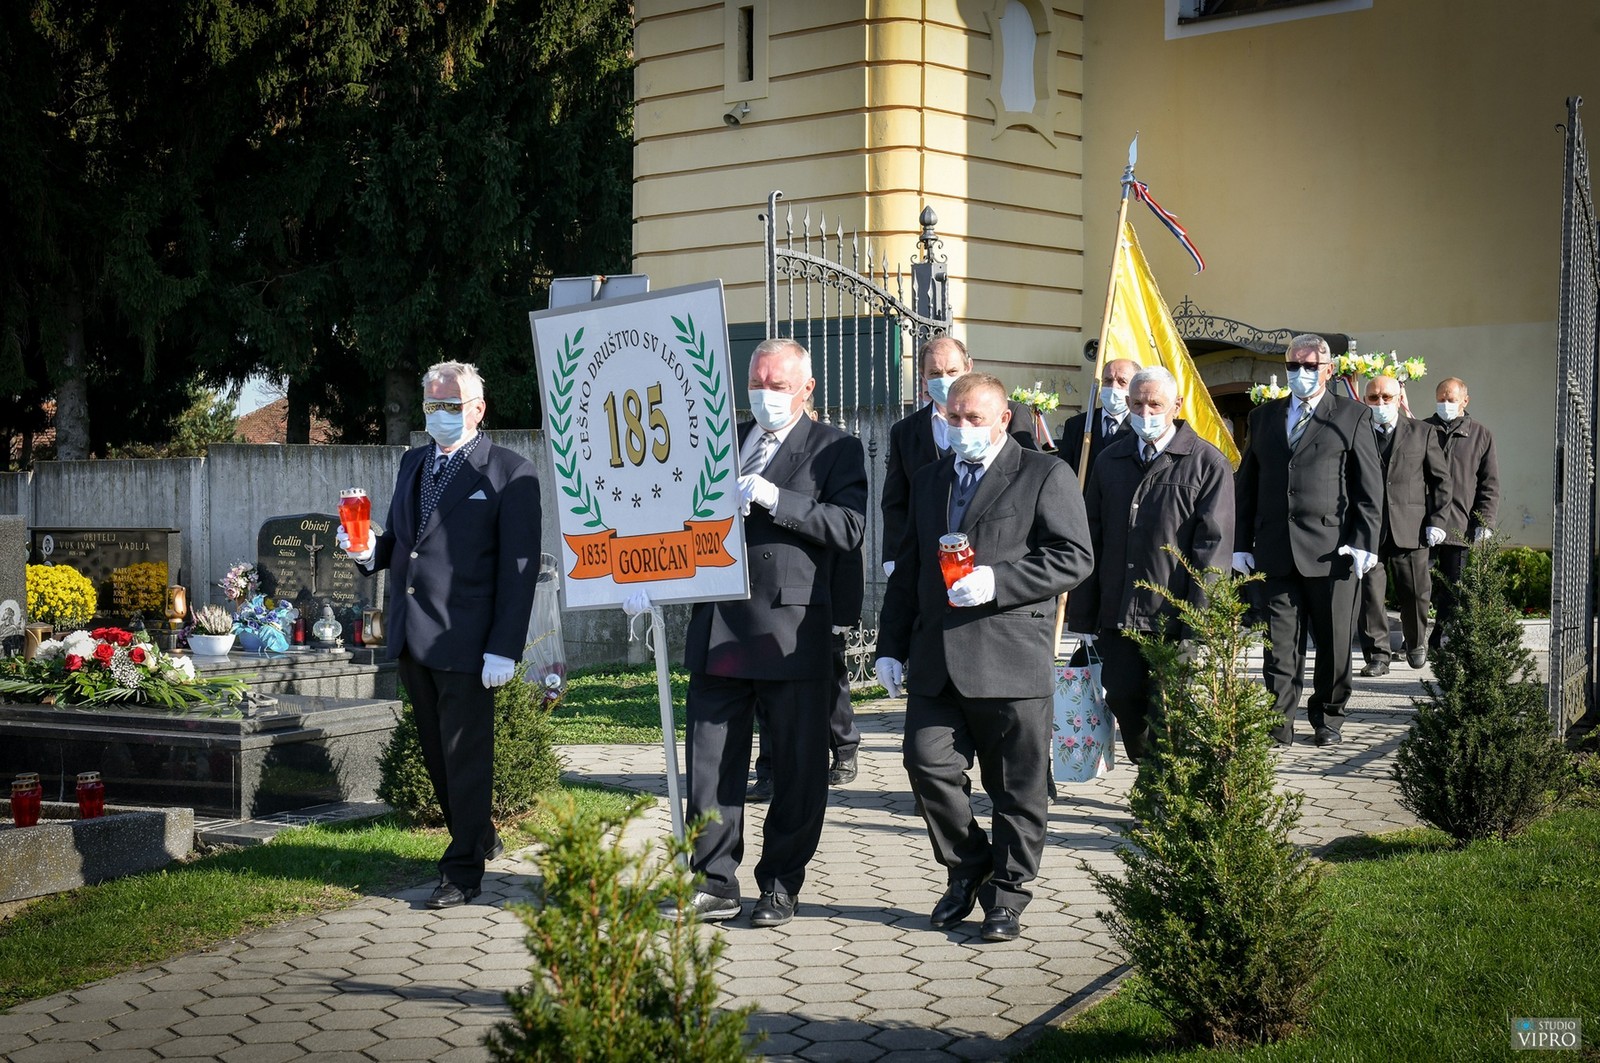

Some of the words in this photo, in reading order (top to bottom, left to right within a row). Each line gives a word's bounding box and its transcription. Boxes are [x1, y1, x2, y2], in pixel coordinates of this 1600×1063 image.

[587, 329, 640, 380] DRUŠTVO
[643, 331, 659, 352] SV
[661, 343, 699, 449] LEONARD
[603, 381, 671, 469] 185
[83, 533, 116, 542] OBITELJ
[300, 520, 331, 533] Obitelj
[272, 535, 302, 547] Gudlin
[581, 543, 608, 566] 1835
[619, 538, 689, 575] GORIČAN
[695, 532, 720, 556] 2020
